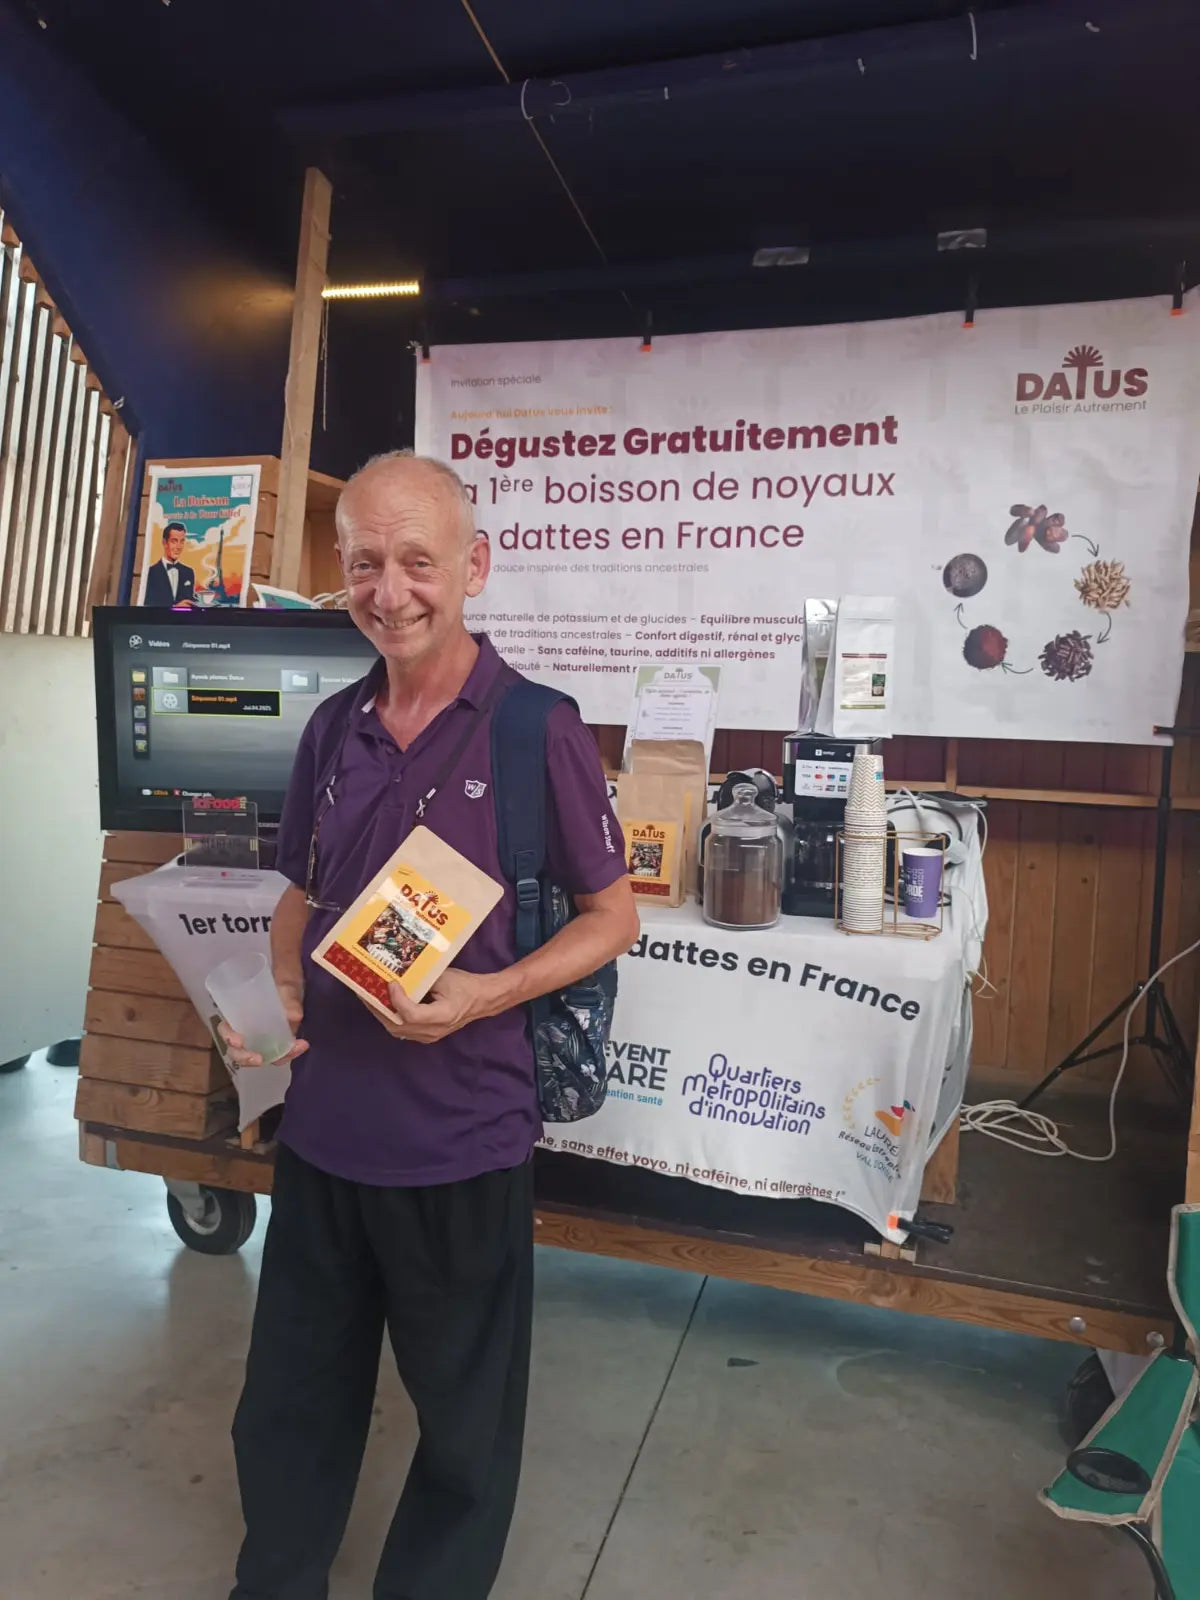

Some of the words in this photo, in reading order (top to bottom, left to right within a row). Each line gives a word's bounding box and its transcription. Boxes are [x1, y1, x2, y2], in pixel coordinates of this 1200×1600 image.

[451, 377, 495, 388] Invitation
[498, 374, 541, 387] spéciale
[1016, 345, 1148, 401] DATUS
[1014, 404, 1028, 415] Le
[1032, 402, 1069, 414] Plaisir
[1073, 400, 1147, 413] Autrement
[451, 426, 616, 469] Dégustez
[622, 415, 899, 456] Gratuitement
[544, 473, 681, 505] boisson
[692, 471, 740, 501] de
[751, 471, 897, 508] noyaux
[499, 522, 611, 551] dattes
[621, 526, 665, 550] en
[676, 521, 805, 550] France
[493, 562, 525, 573] douce
[570, 562, 590, 573] des
[592, 562, 642, 573] traditions
[645, 562, 709, 574] ancestrales
[463, 613, 487, 622] urce
[489, 612, 535, 622] naturelle
[537, 613, 550, 623] de
[552, 613, 608, 624] potassium
[610, 614, 621, 623] et
[624, 613, 638, 623] de
[640, 614, 687, 626] glucides
[753, 614, 806, 625] muscula
[494, 628, 507, 638] de
[509, 629, 558, 639] traditions
[560, 629, 622, 640] ancestrales
[635, 630, 677, 642] Confort
[679, 631, 725, 644] digestif,
[727, 631, 758, 642] rénal
[760, 632, 772, 642] et
[775, 632, 804, 645] glyc
[537, 645, 562, 656] Sans
[565, 645, 608, 657] caféine,
[610, 646, 653, 658] taurine,
[655, 647, 698, 659] additifs
[700, 648, 711, 659] ni
[713, 648, 775, 662] allergènes
[552, 662, 630, 674] Naturellement
[663, 668, 693, 680] DATUS
[632, 824, 666, 839] DATUS
[401, 883, 449, 926] DATUS
[222, 912, 273, 934] torr
[627, 933, 740, 972] dattes
[747, 956, 792, 983] en
[798, 962, 921, 1022] France
[606, 1060, 669, 1092] ARE
[708, 1053, 803, 1095] Quartiers
[606, 1088, 635, 1101] ention
[560, 1137, 593, 1154] sans
[596, 1145, 629, 1162] effet
[632, 1153, 672, 1172] yoyo,
[675, 1162, 690, 1175] ni
[692, 1166, 751, 1192] caféine,
[754, 1177, 768, 1191] ni
[770, 1180, 833, 1200] allergènes
